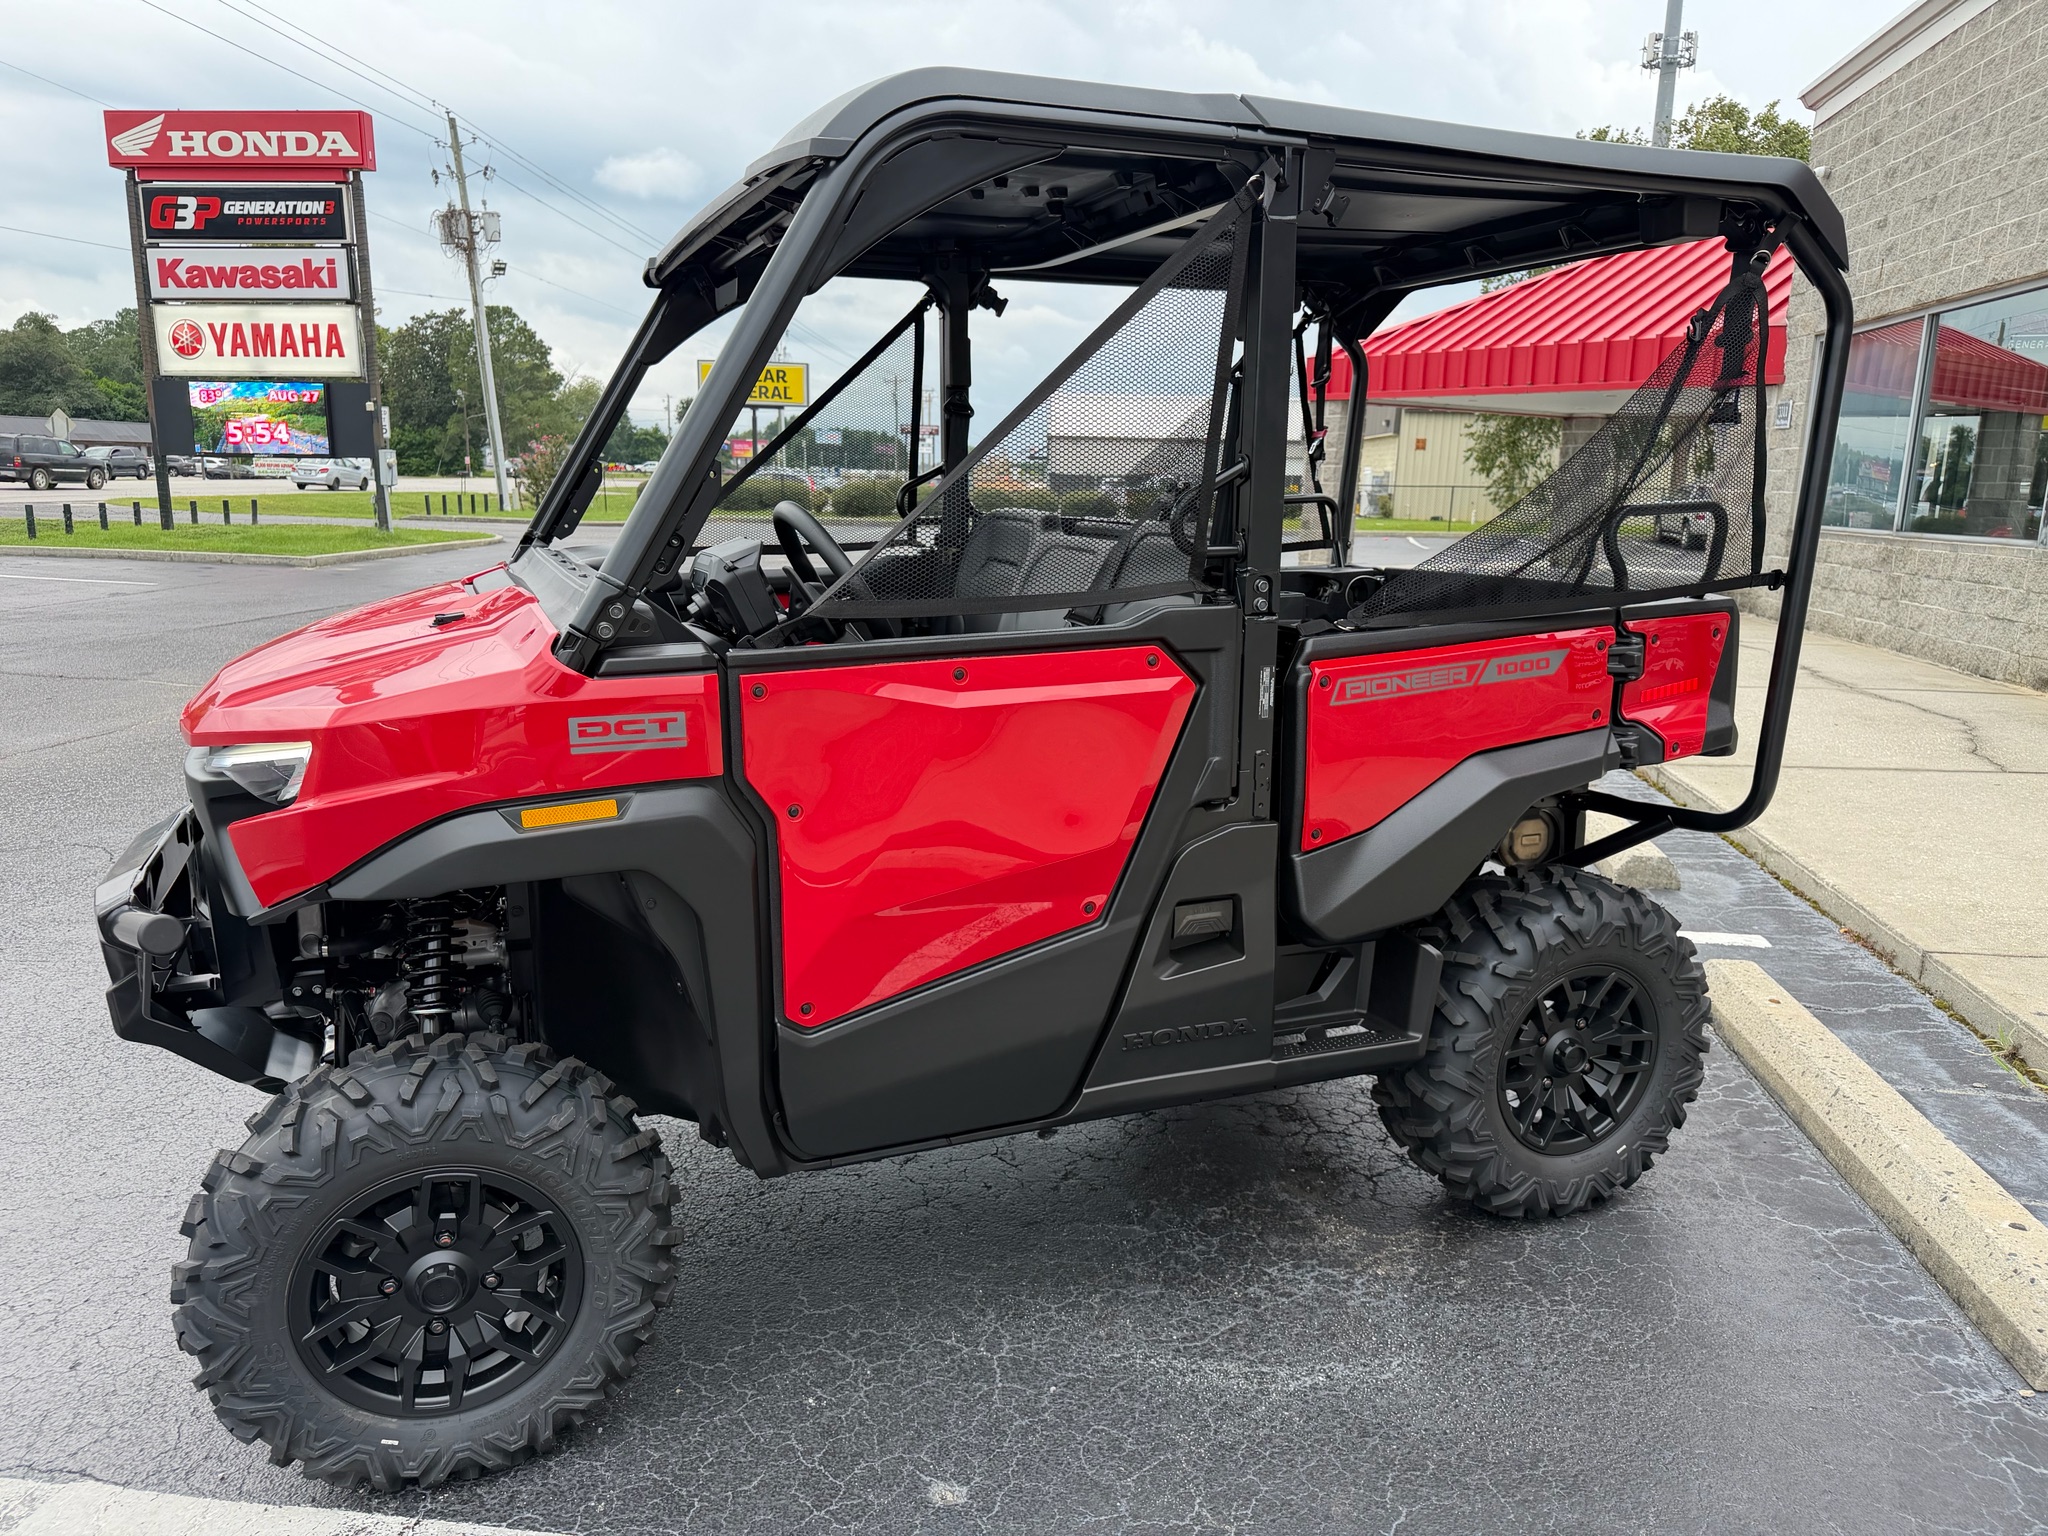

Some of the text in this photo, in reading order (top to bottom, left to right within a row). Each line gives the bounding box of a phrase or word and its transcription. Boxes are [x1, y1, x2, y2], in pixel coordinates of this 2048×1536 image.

[167, 131, 359, 157] HONDA
[150, 196, 221, 229] G3P
[156, 258, 338, 289] Kawasaki
[207, 323, 346, 358] YAMAHA
[268, 391, 320, 402] AUG 27
[226, 422, 290, 444] 5:54
[1346, 667, 1468, 699] PIONEER
[1495, 657, 1550, 677] 1000
[577, 717, 678, 738] DCT
[1122, 1018, 1256, 1051] HONDA
